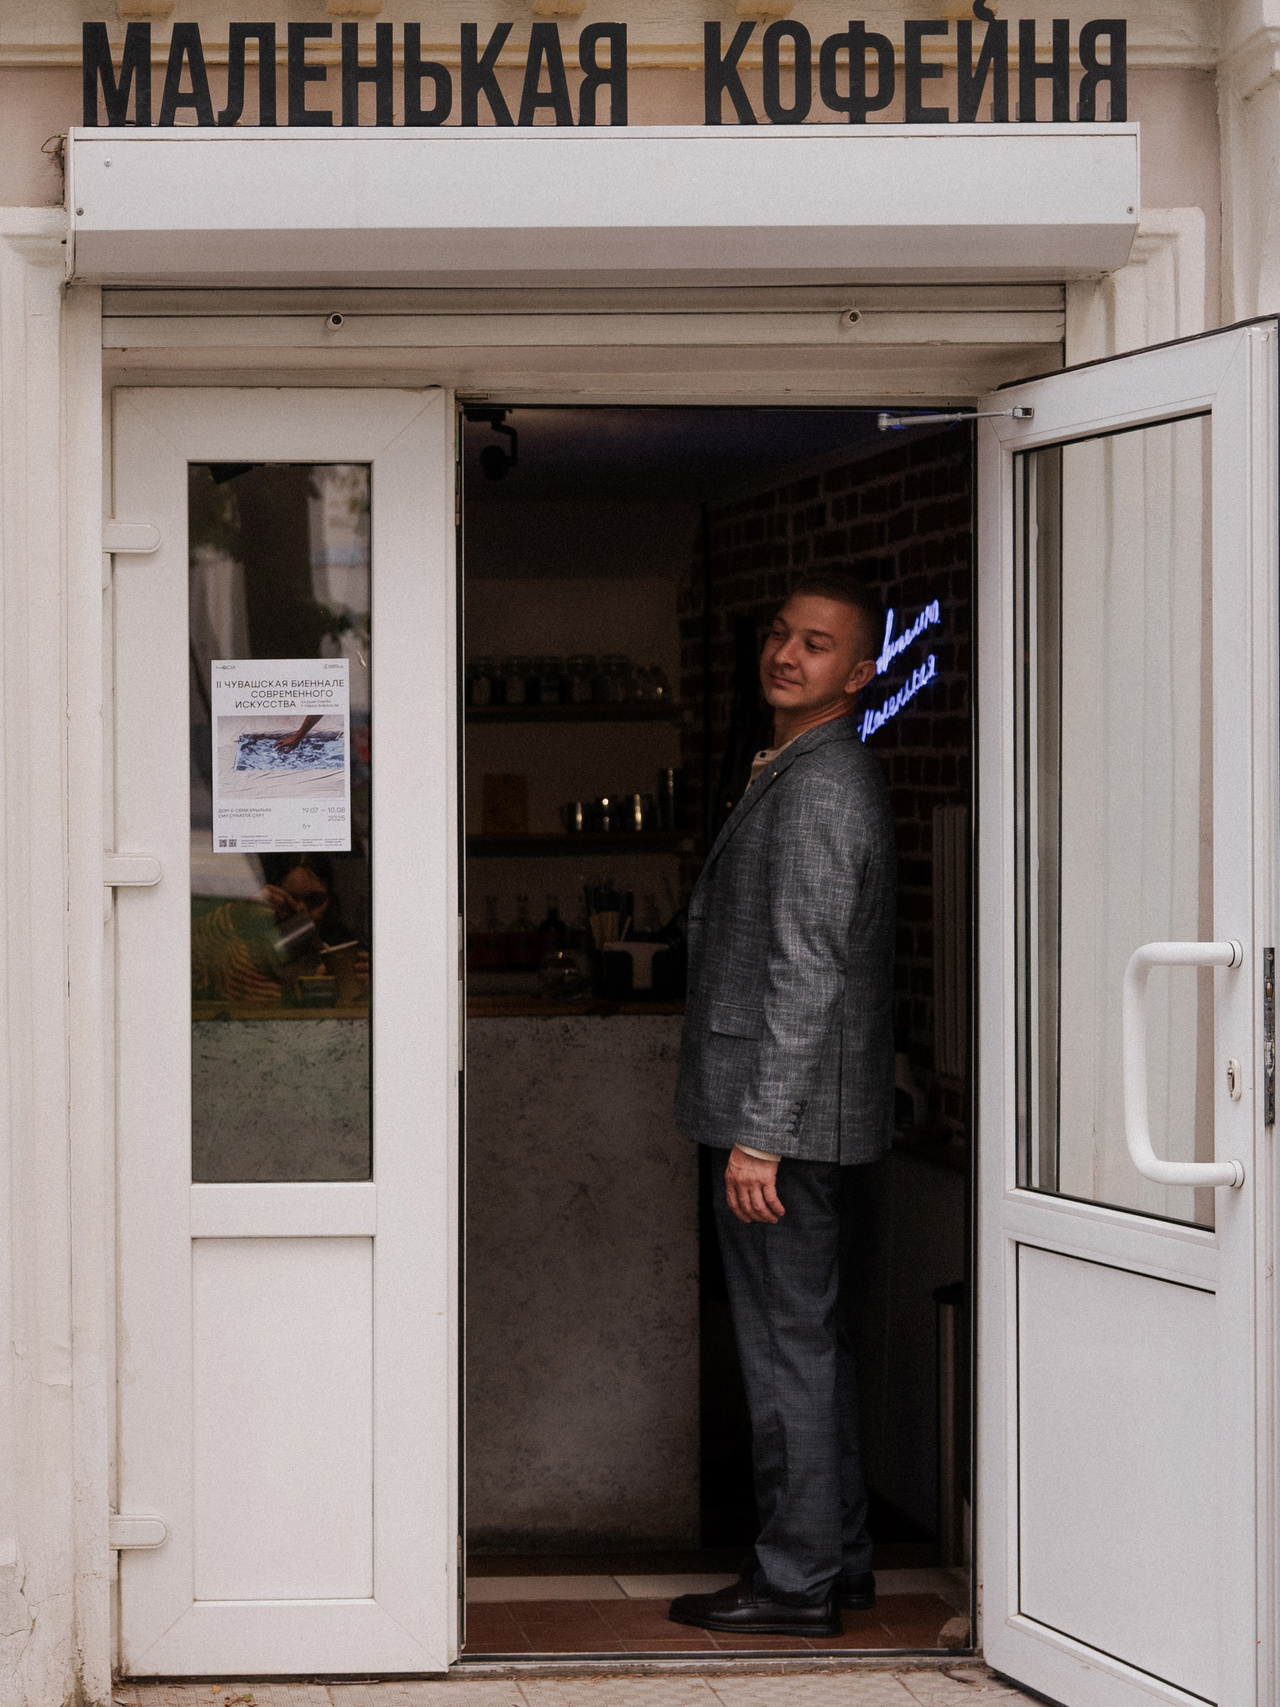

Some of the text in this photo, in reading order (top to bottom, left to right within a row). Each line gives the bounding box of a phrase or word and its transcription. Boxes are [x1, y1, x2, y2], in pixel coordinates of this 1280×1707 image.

[82, 0, 1128, 126] МАЛЕНЬКАЯ КОФЕЙНЯ
[224, 680, 288, 689] ЧУВАШСКАЯ
[291, 679, 345, 688] БИЕННАЛЕ
[250, 689, 334, 698] СОВРЕМЕННОГО
[235, 700, 297, 709] ИСКУССТВА
